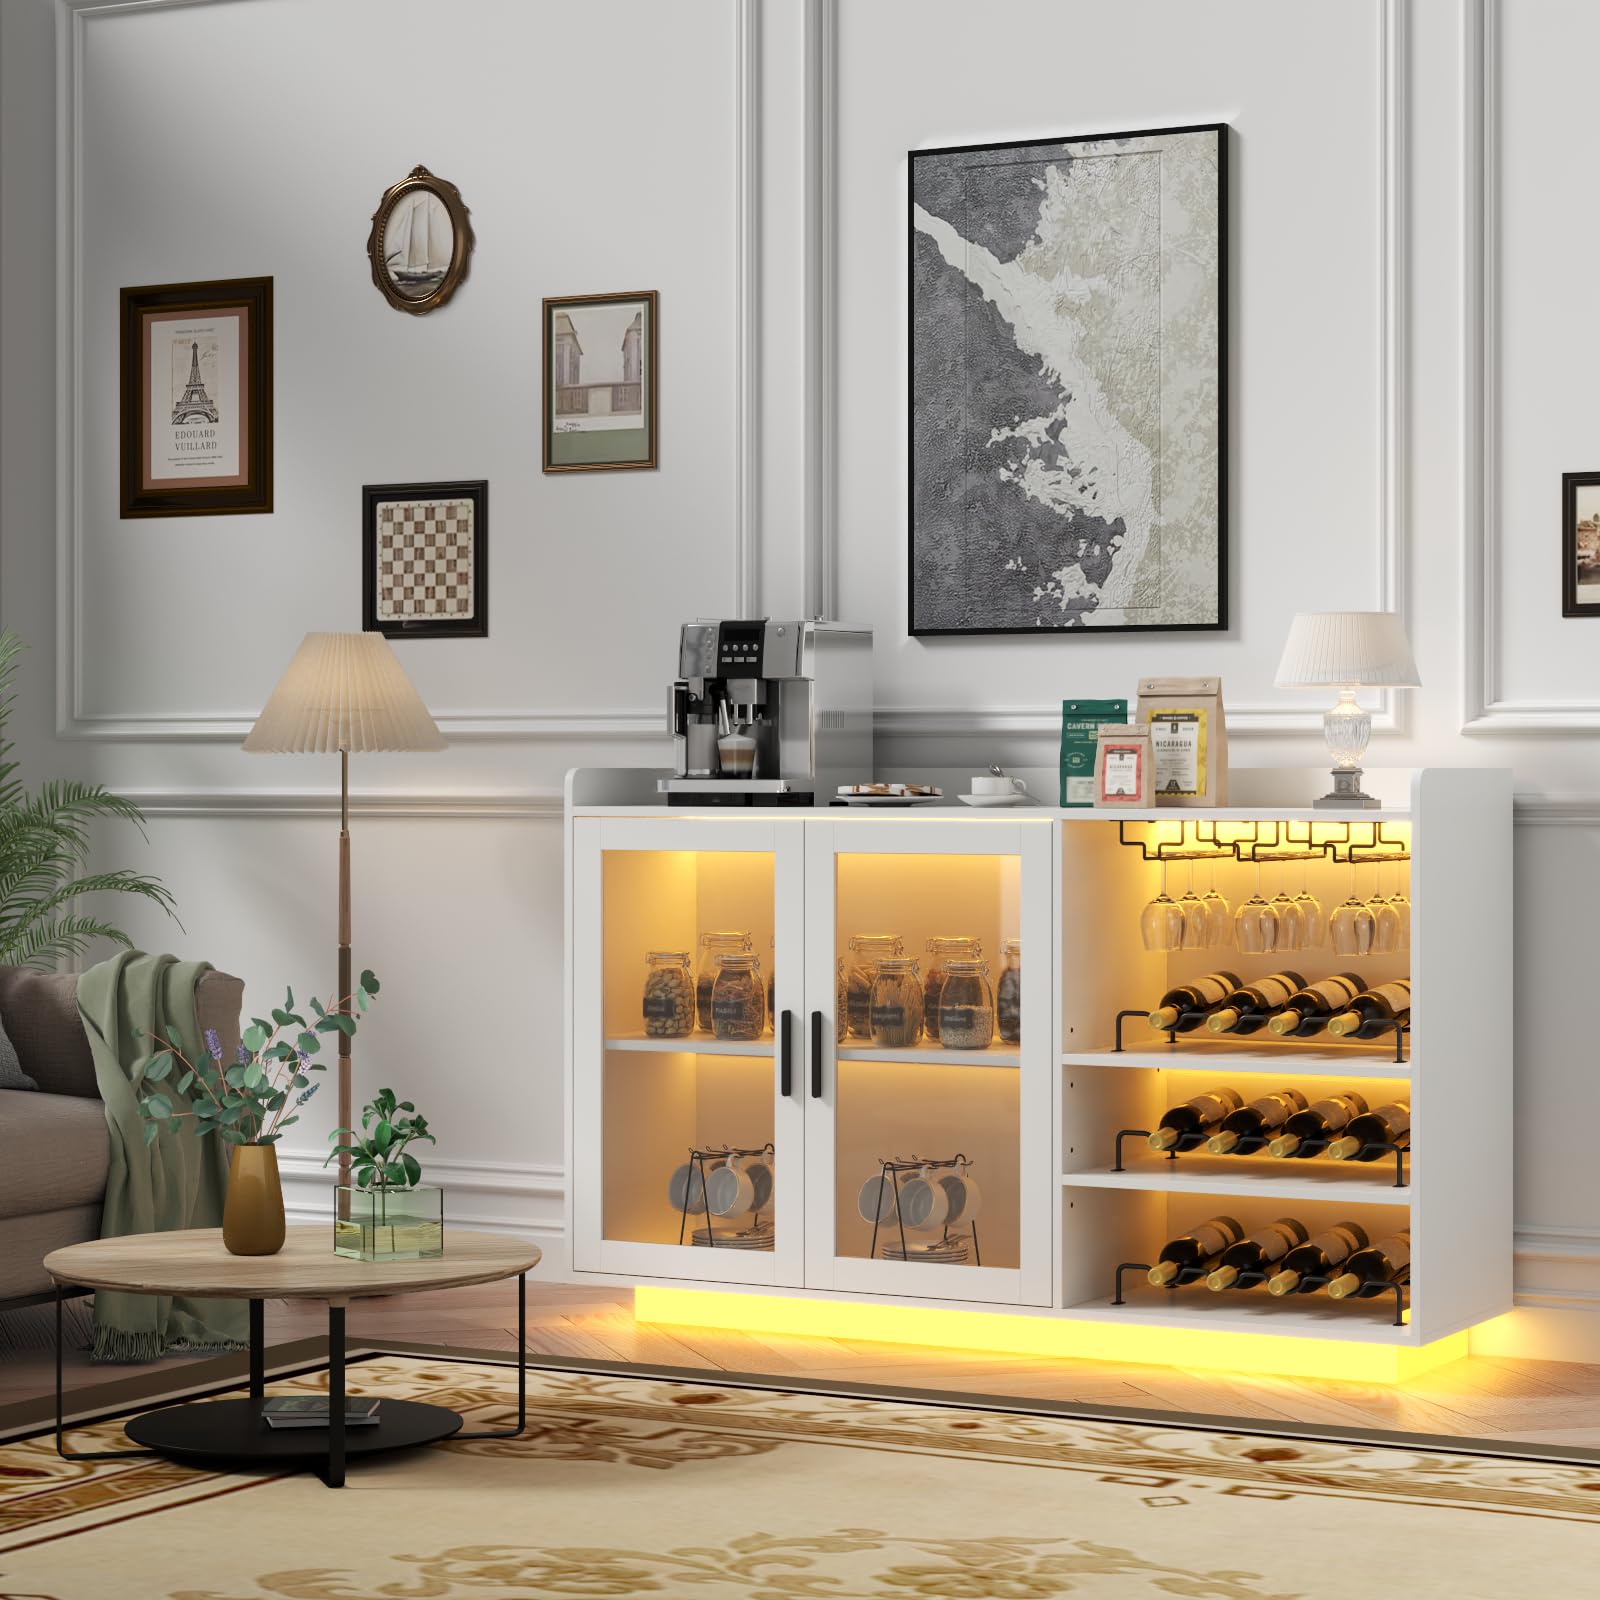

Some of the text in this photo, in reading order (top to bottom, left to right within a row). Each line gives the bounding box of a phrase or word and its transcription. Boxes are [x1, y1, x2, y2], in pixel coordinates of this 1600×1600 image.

[175, 429, 216, 440] EDOUARD
[175, 441, 217, 451] VUILLARD
[1067, 722, 1096, 730] CAVERN
[1155, 740, 1192, 748] NICARAGUA
